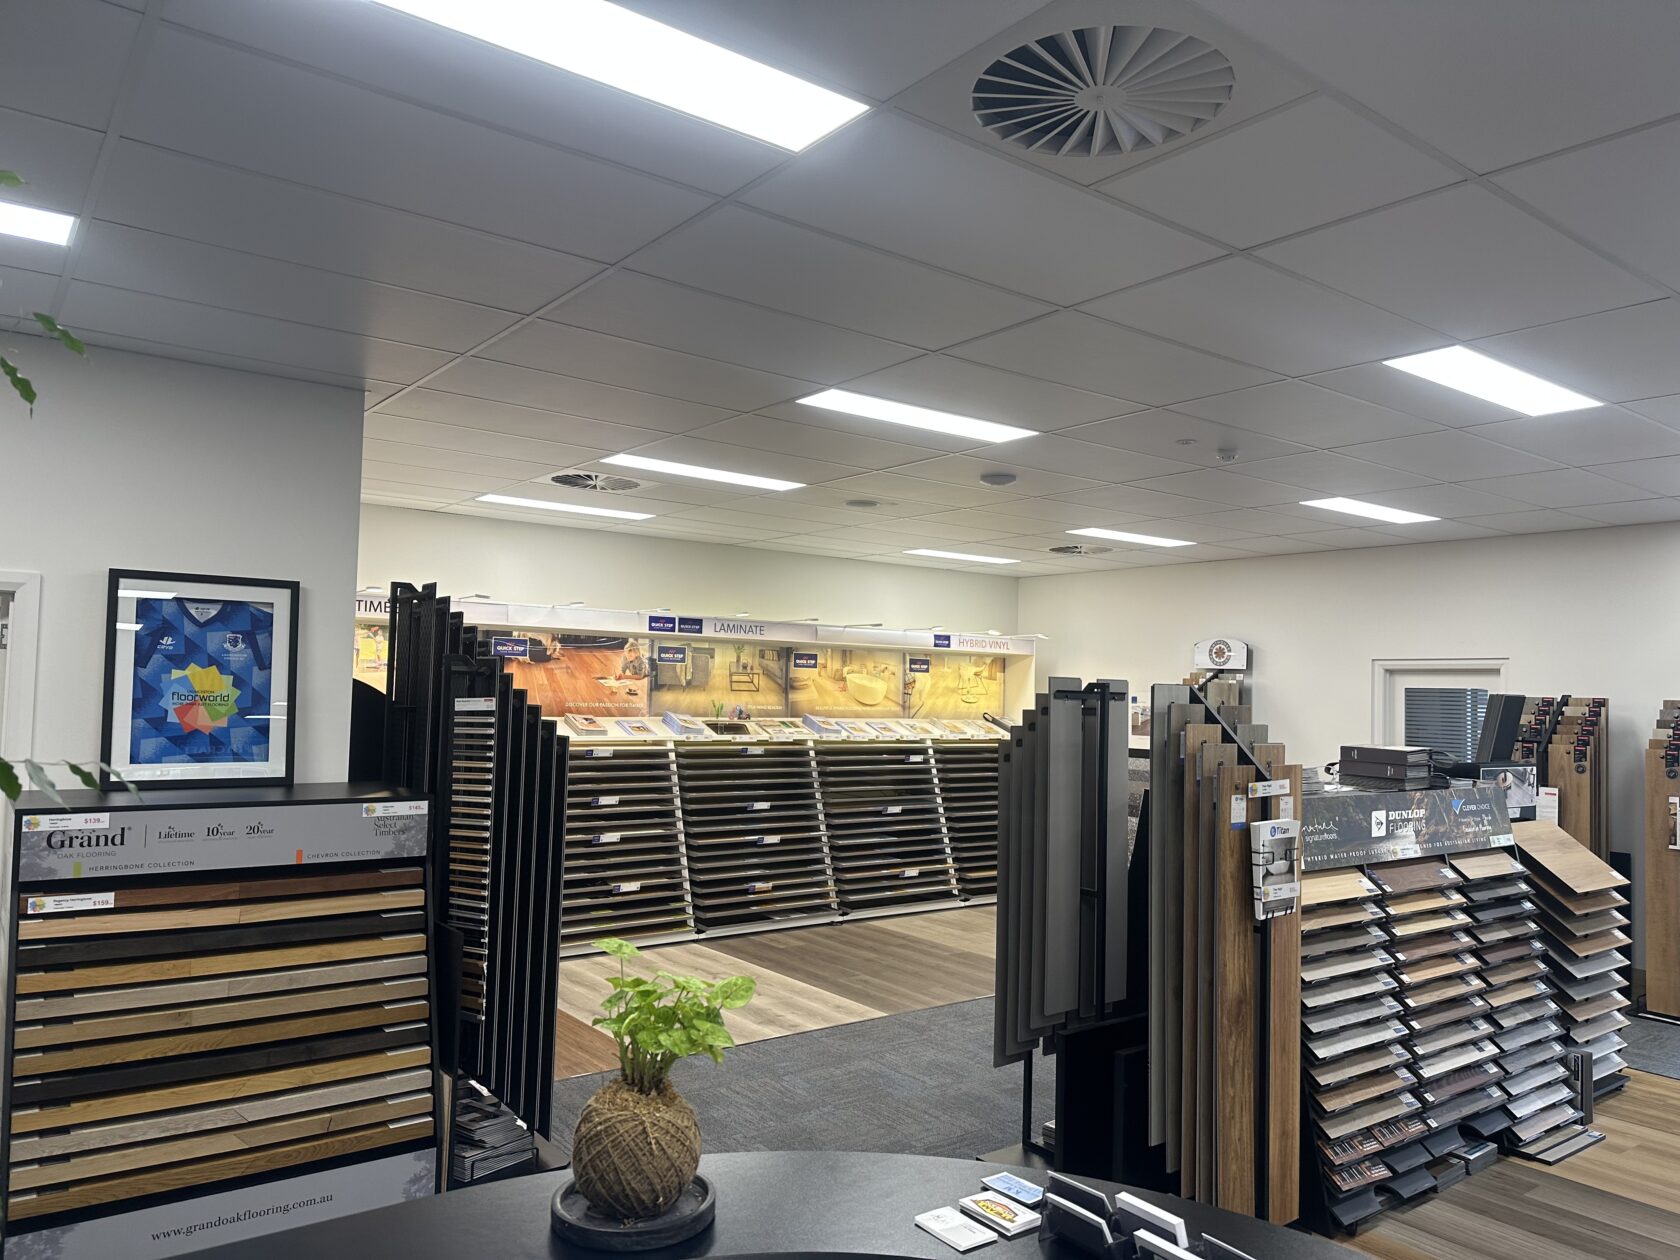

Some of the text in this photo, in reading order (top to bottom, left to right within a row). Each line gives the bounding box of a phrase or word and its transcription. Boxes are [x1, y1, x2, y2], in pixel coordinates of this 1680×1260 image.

[714, 622, 765, 636] LAMINATE
[958, 637, 1010, 650] HYBRID VINYL
[171, 691, 230, 702] floorworld
[1388, 809, 1426, 820] DUNLOP
[245, 825, 275, 836] 20 year
[374, 821, 398, 830] Select
[1276, 826, 1290, 836] Titan
[1389, 820, 1426, 834] FLOORING
[46, 826, 126, 850] Grand
[158, 830, 196, 840] Lifetime
[206, 826, 236, 839] 10 year
[374, 829, 407, 837] Timbers
[56, 850, 118, 860] OAK FLOORING
[306, 849, 382, 860] CHEVRON COLLECTION
[1307, 854, 1328, 862] HYBRID
[88, 860, 196, 872] HERRINGBONE COLLECTION
[151, 1193, 334, 1242] www.grandoakflooring.com.au
